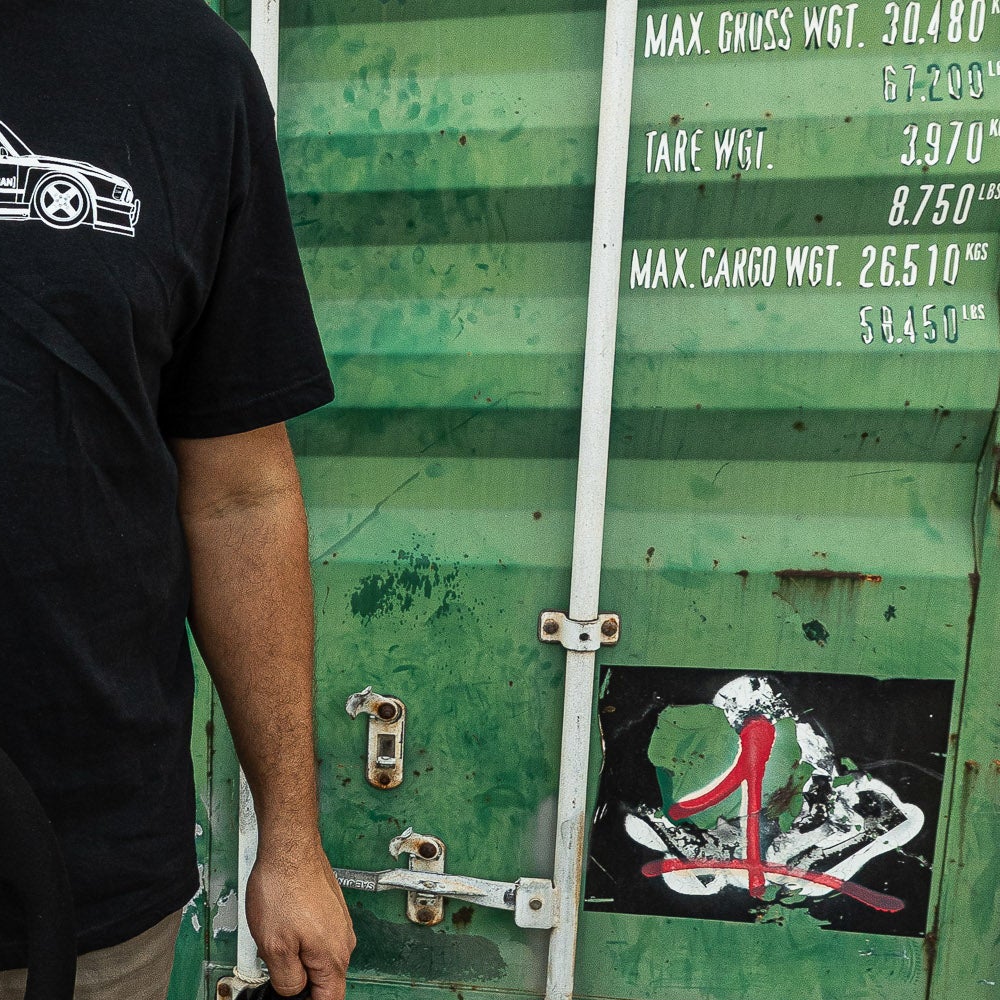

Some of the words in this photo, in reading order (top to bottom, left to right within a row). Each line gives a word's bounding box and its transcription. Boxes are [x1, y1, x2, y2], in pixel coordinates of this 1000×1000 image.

[644, 11, 711, 58] MAX.
[718, 6, 794, 54] GROSS
[803, 3, 865, 49] WGT.
[882, 0, 986, 45] 30.480
[883, 62, 984, 103] 67.200
[645, 128, 704, 174] TARE
[714, 126, 774, 172] WGT.
[900, 120, 984, 167] 3.970
[888, 183, 976, 227] 8.750
[978, 182, 1000, 201] LBS
[629, 247, 695, 290] MAX.
[701, 245, 777, 288] CARGO
[785, 244, 843, 287] WGT.
[859, 243, 961, 288] 26.510
[964, 242, 989, 262] KGS
[859, 304, 958, 344] 58.450
[961, 303, 986, 321] LBS
